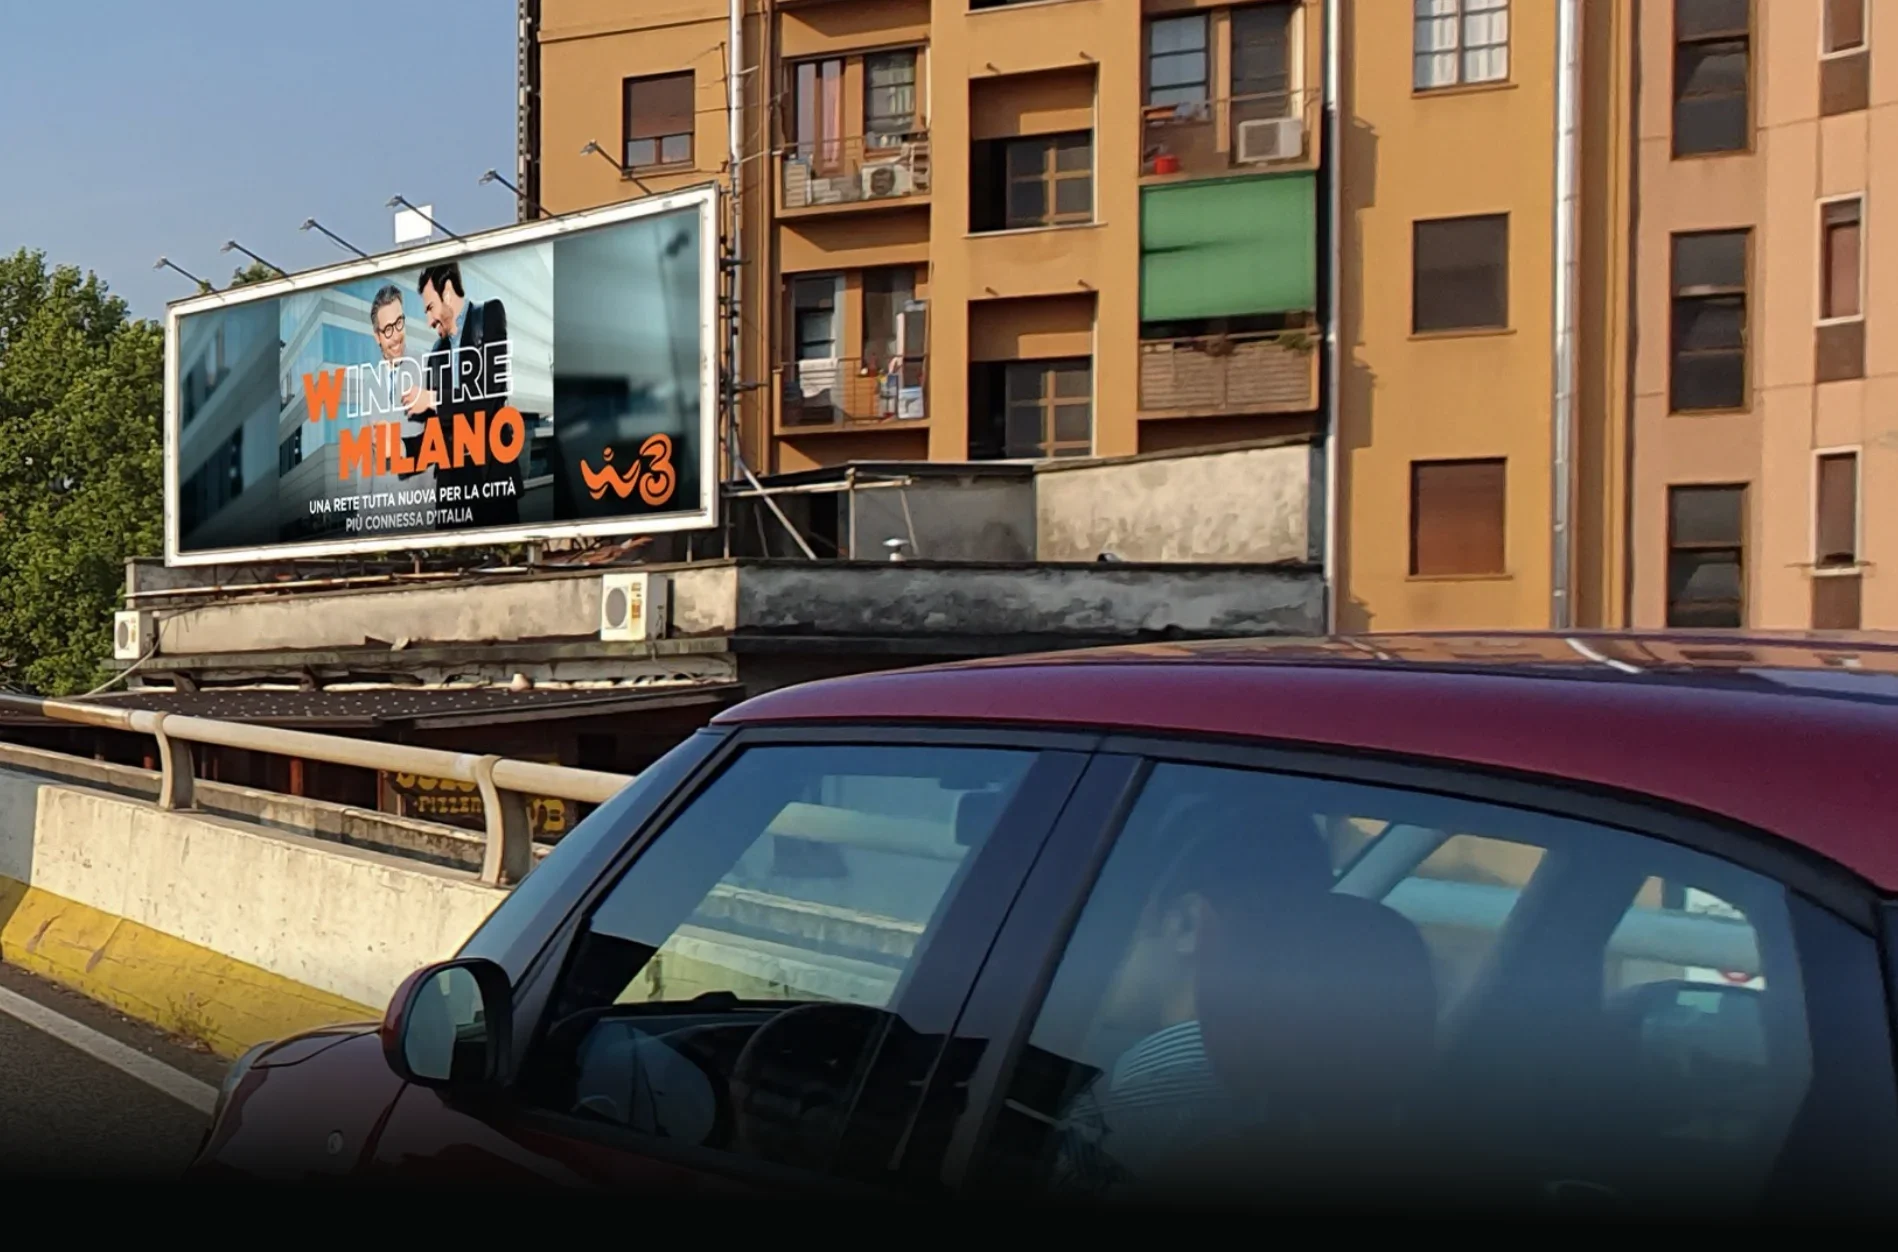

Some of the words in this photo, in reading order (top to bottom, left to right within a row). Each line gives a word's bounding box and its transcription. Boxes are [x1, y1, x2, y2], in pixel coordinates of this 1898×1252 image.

[302, 339, 514, 424] WINDTRE
[339, 405, 526, 481] MILANO
[309, 499, 332, 514] UNA
[333, 495, 360, 512] RETE
[362, 492, 396, 509] TUTTA
[398, 488, 437, 506] NUOVA
[440, 485, 462, 502] PER
[464, 484, 480, 500] LA
[482, 476, 517, 499] CITTÀ
[345, 513, 363, 532] PIÙ
[365, 511, 424, 530] CONNESSA
[426, 506, 474, 525] D'ITALIA
[418, 795, 482, 814] PIZZER
